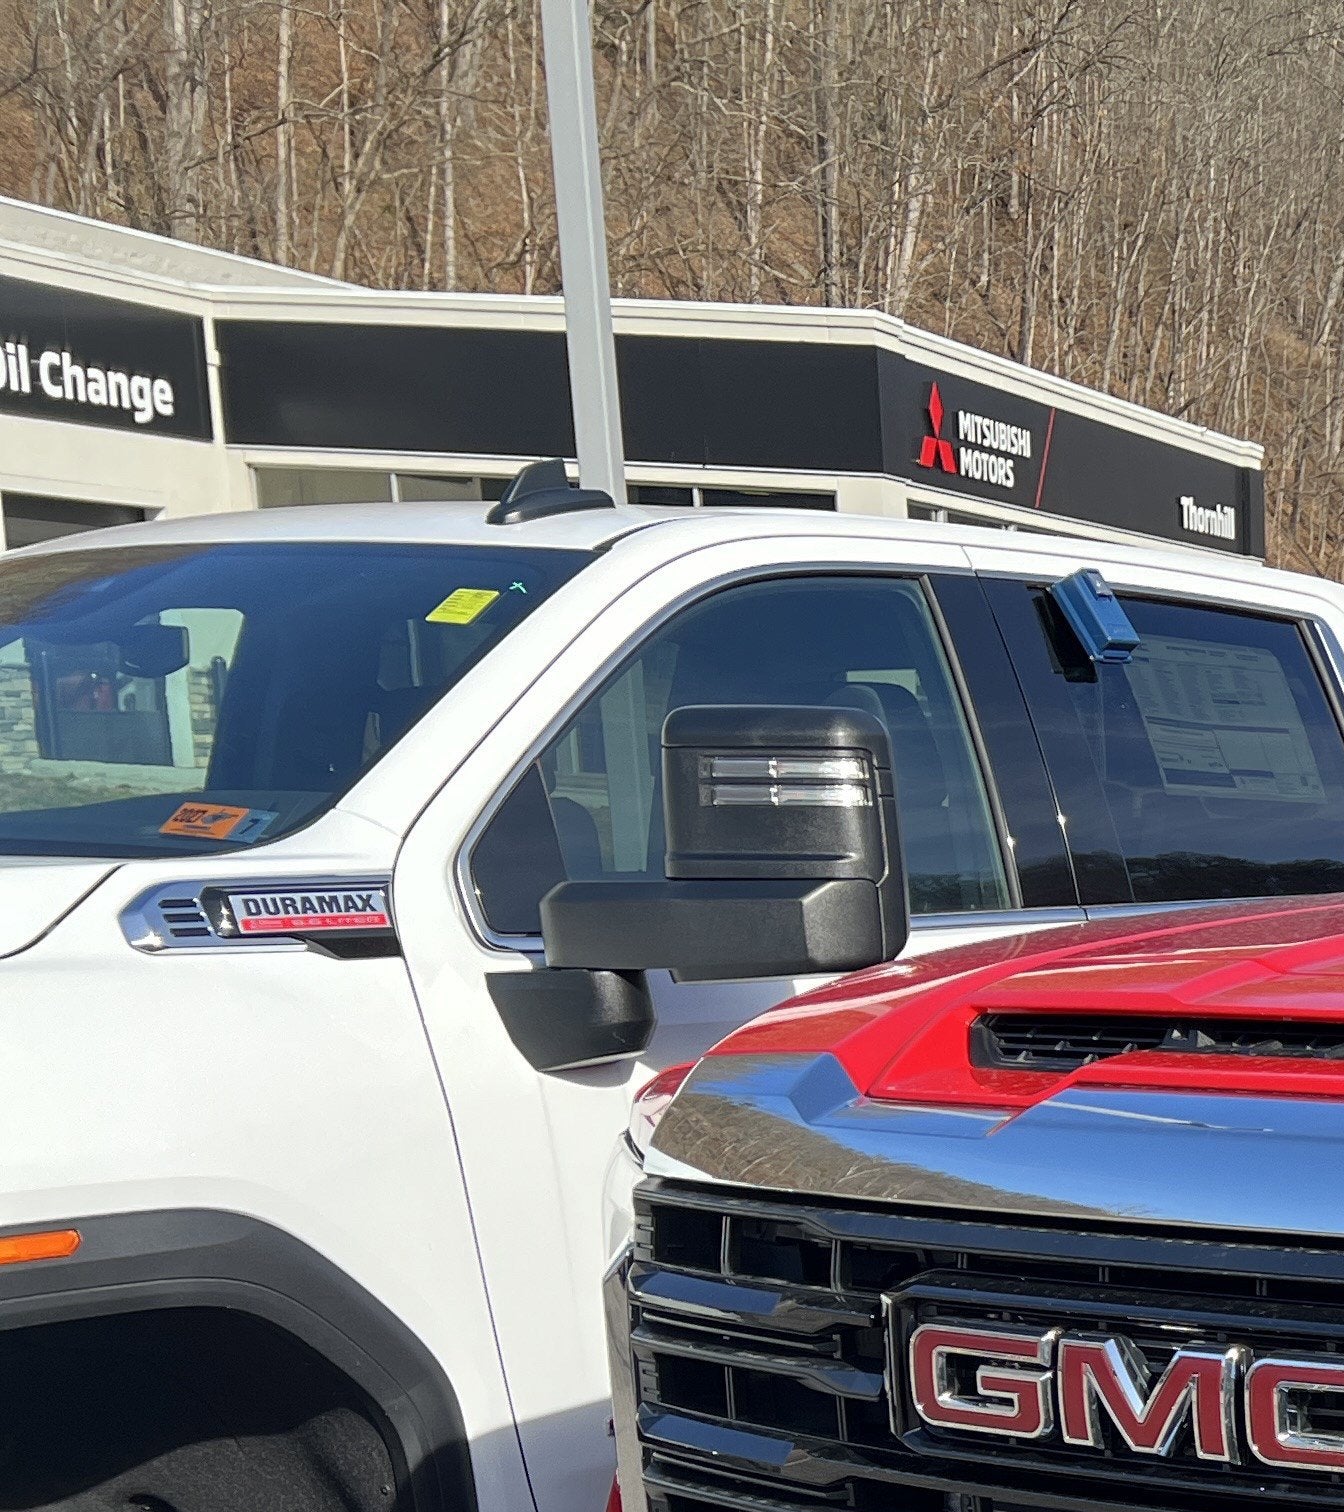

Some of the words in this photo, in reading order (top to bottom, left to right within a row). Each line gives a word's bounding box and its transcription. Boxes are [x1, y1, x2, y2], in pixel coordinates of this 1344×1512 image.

[38, 349, 175, 424] Change
[958, 409, 1031, 459] MITSUBISHI
[959, 446, 1014, 488] MOTORS
[1179, 495, 1236, 540] Thornhill
[241, 893, 377, 916] DURAMAX
